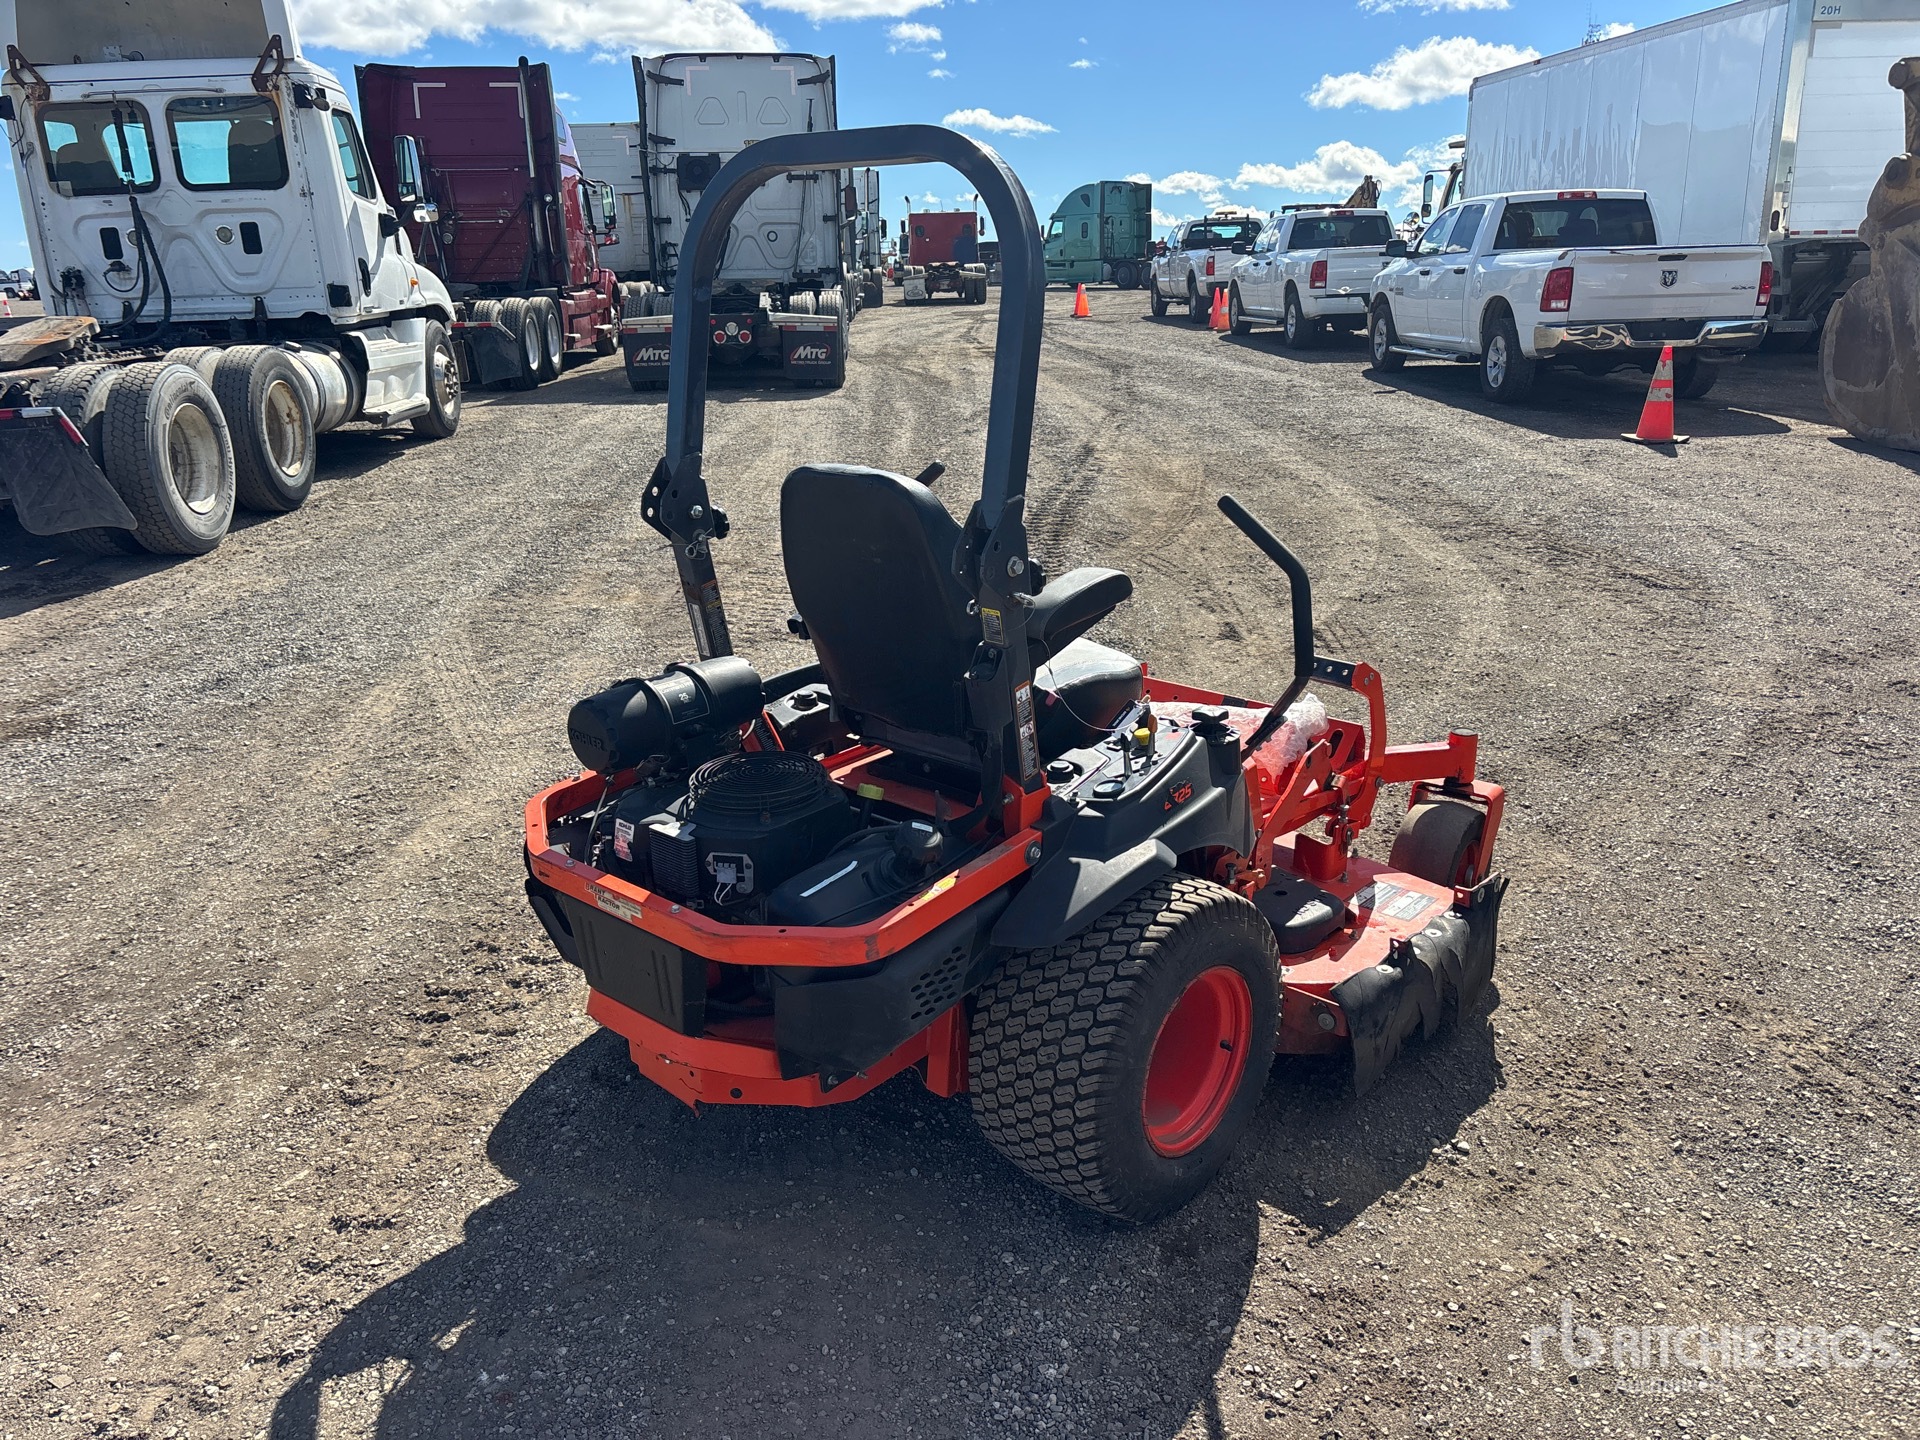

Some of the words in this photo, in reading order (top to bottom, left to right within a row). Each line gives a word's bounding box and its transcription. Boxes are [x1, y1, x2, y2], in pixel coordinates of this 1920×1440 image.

[1820, 5, 1841, 15] 20H
[636, 347, 670, 360] MTG
[793, 346, 827, 359] MTG
[227, 456, 235, 489] Hybrid
[679, 692, 689, 701] 25
[570, 728, 605, 752] KOHLER
